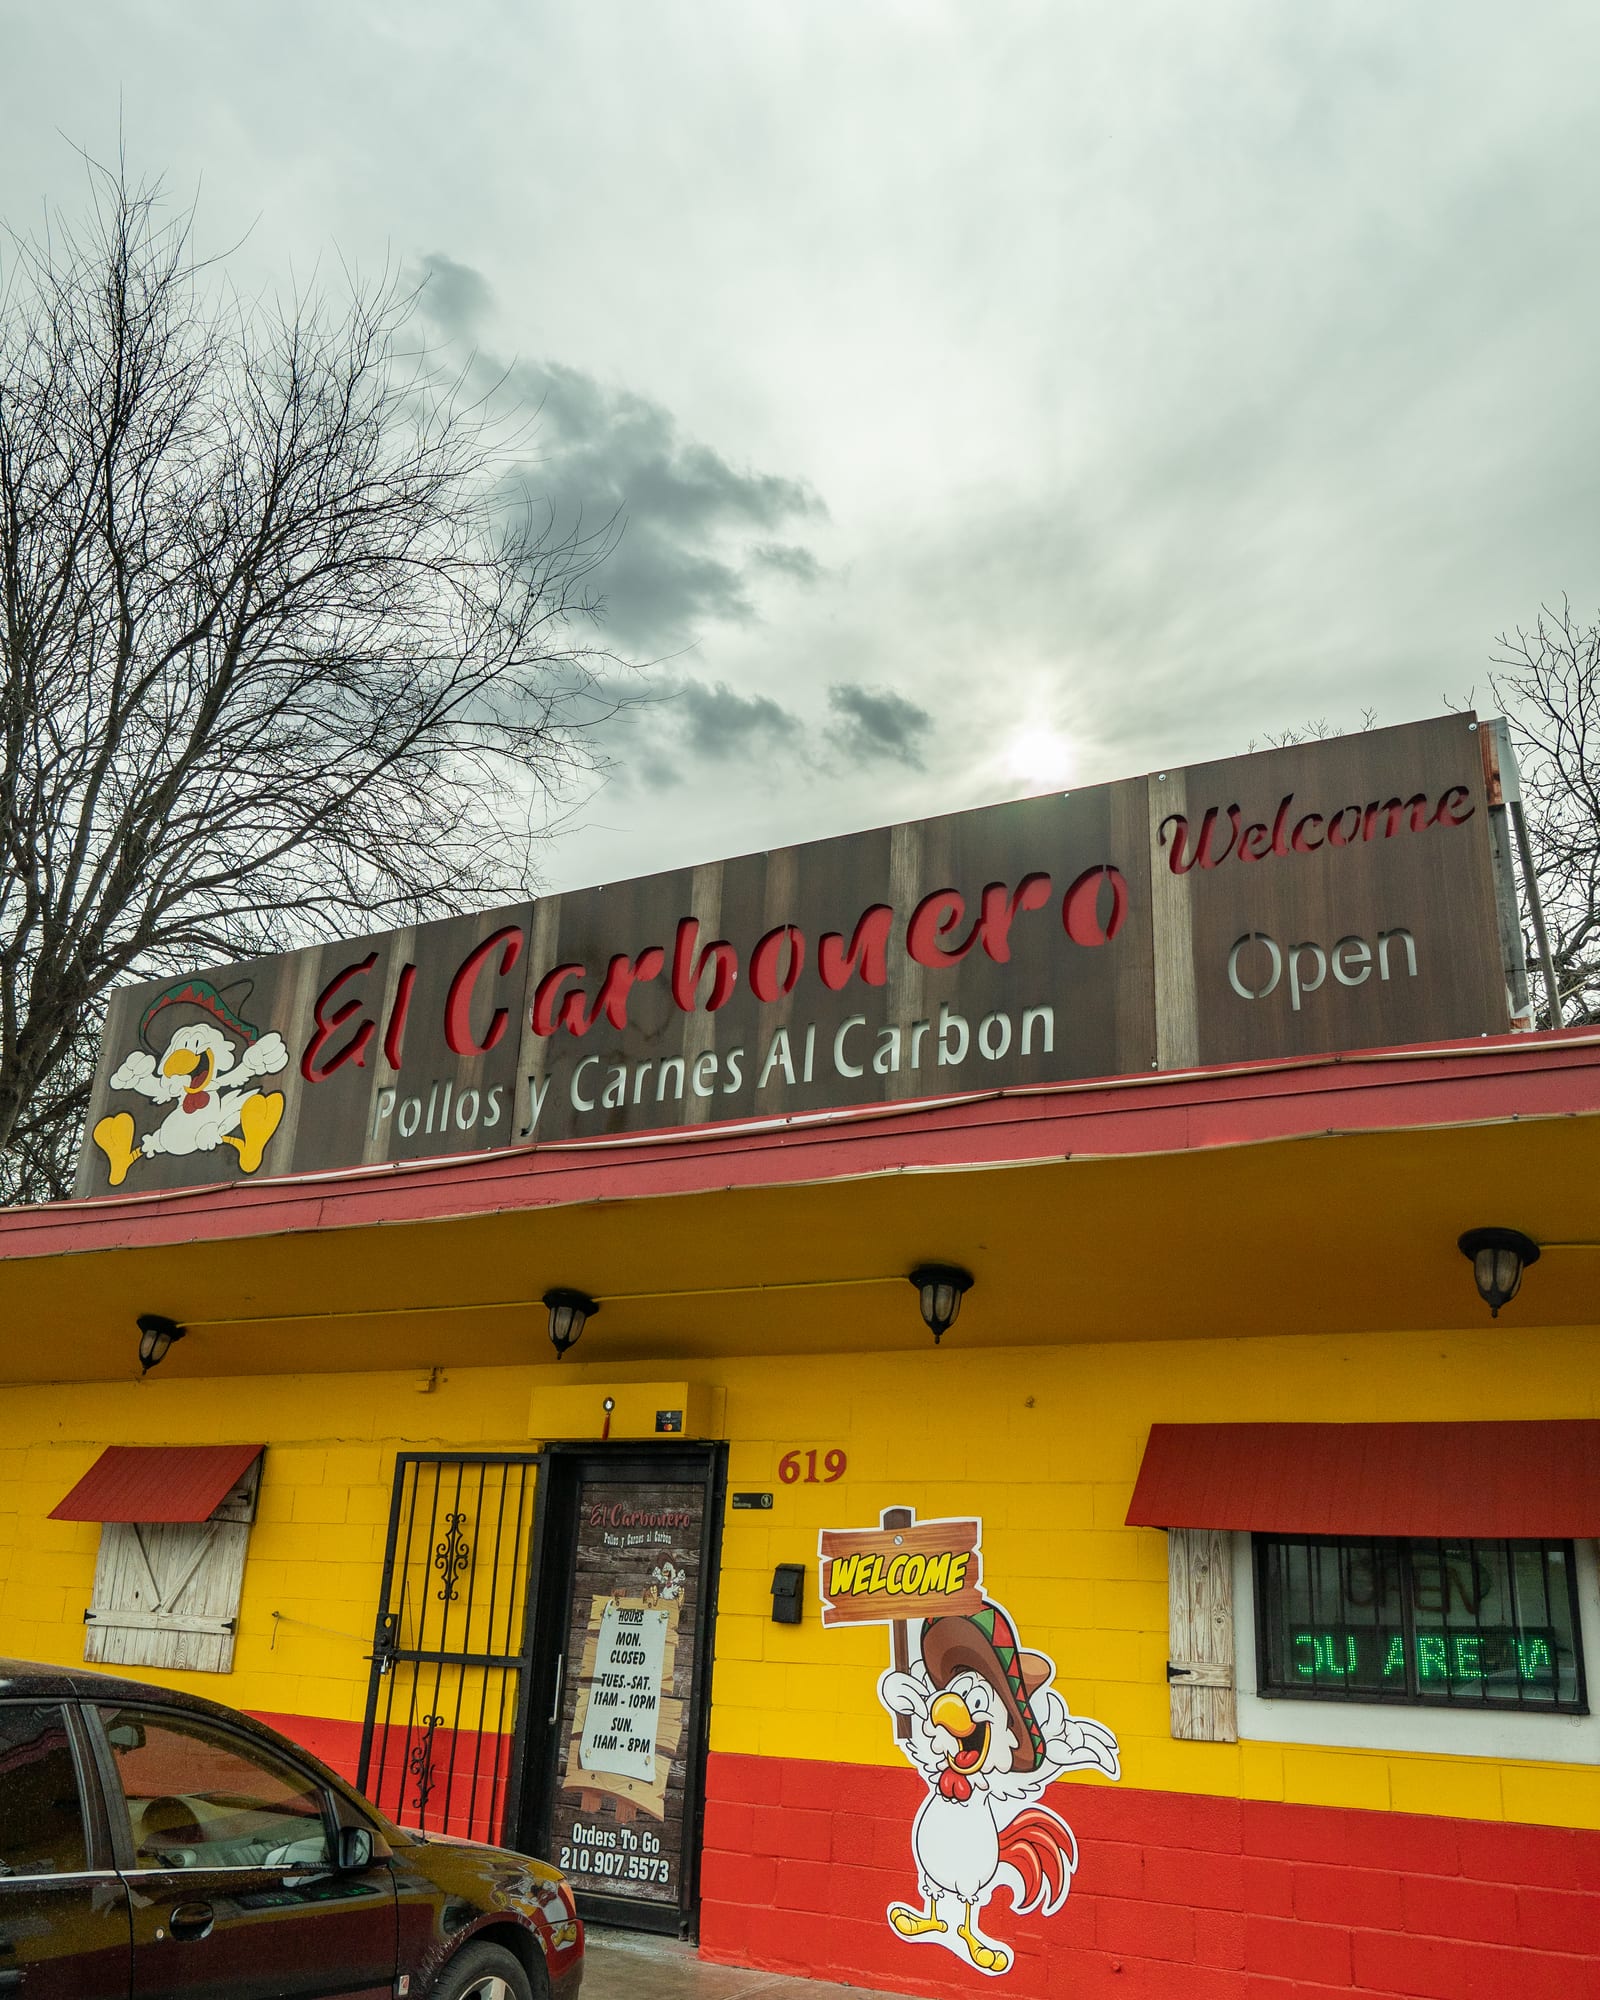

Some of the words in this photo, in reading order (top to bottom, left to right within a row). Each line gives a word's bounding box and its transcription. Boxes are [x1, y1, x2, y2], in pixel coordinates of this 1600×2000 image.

[1158, 785, 1476, 875] Welcome
[301, 951, 417, 1083] El
[443, 864, 1129, 1057] Carbonero
[1227, 926, 1418, 1011] Open
[371, 1078, 504, 1139] Pollos
[520, 1073, 553, 1137] y
[569, 1046, 745, 1113] Carnes
[757, 1021, 817, 1089] Al
[833, 1001, 1055, 1079] Carbon
[778, 1448, 847, 1484] 619
[589, 1502, 608, 1527] El
[610, 1503, 691, 1528] Carbonero
[829, 1551, 971, 1597] WELCOME
[618, 1609, 645, 1623] HOURS
[615, 1631, 641, 1647] MON.
[610, 1649, 646, 1666] CLOSED
[1383, 1636, 1488, 1679] ARE
[601, 1672, 651, 1691] TUES.-SAT.
[593, 1691, 618, 1707] 11AM
[628, 1693, 656, 1710] 10PM
[610, 1717, 633, 1733] SUN.
[592, 1734, 618, 1751] 11AM
[627, 1737, 651, 1754] 8PM
[572, 1822, 617, 1849] Orders
[620, 1828, 638, 1851] To
[642, 1831, 660, 1854] Go
[559, 1846, 670, 1884] 210.907.5573
